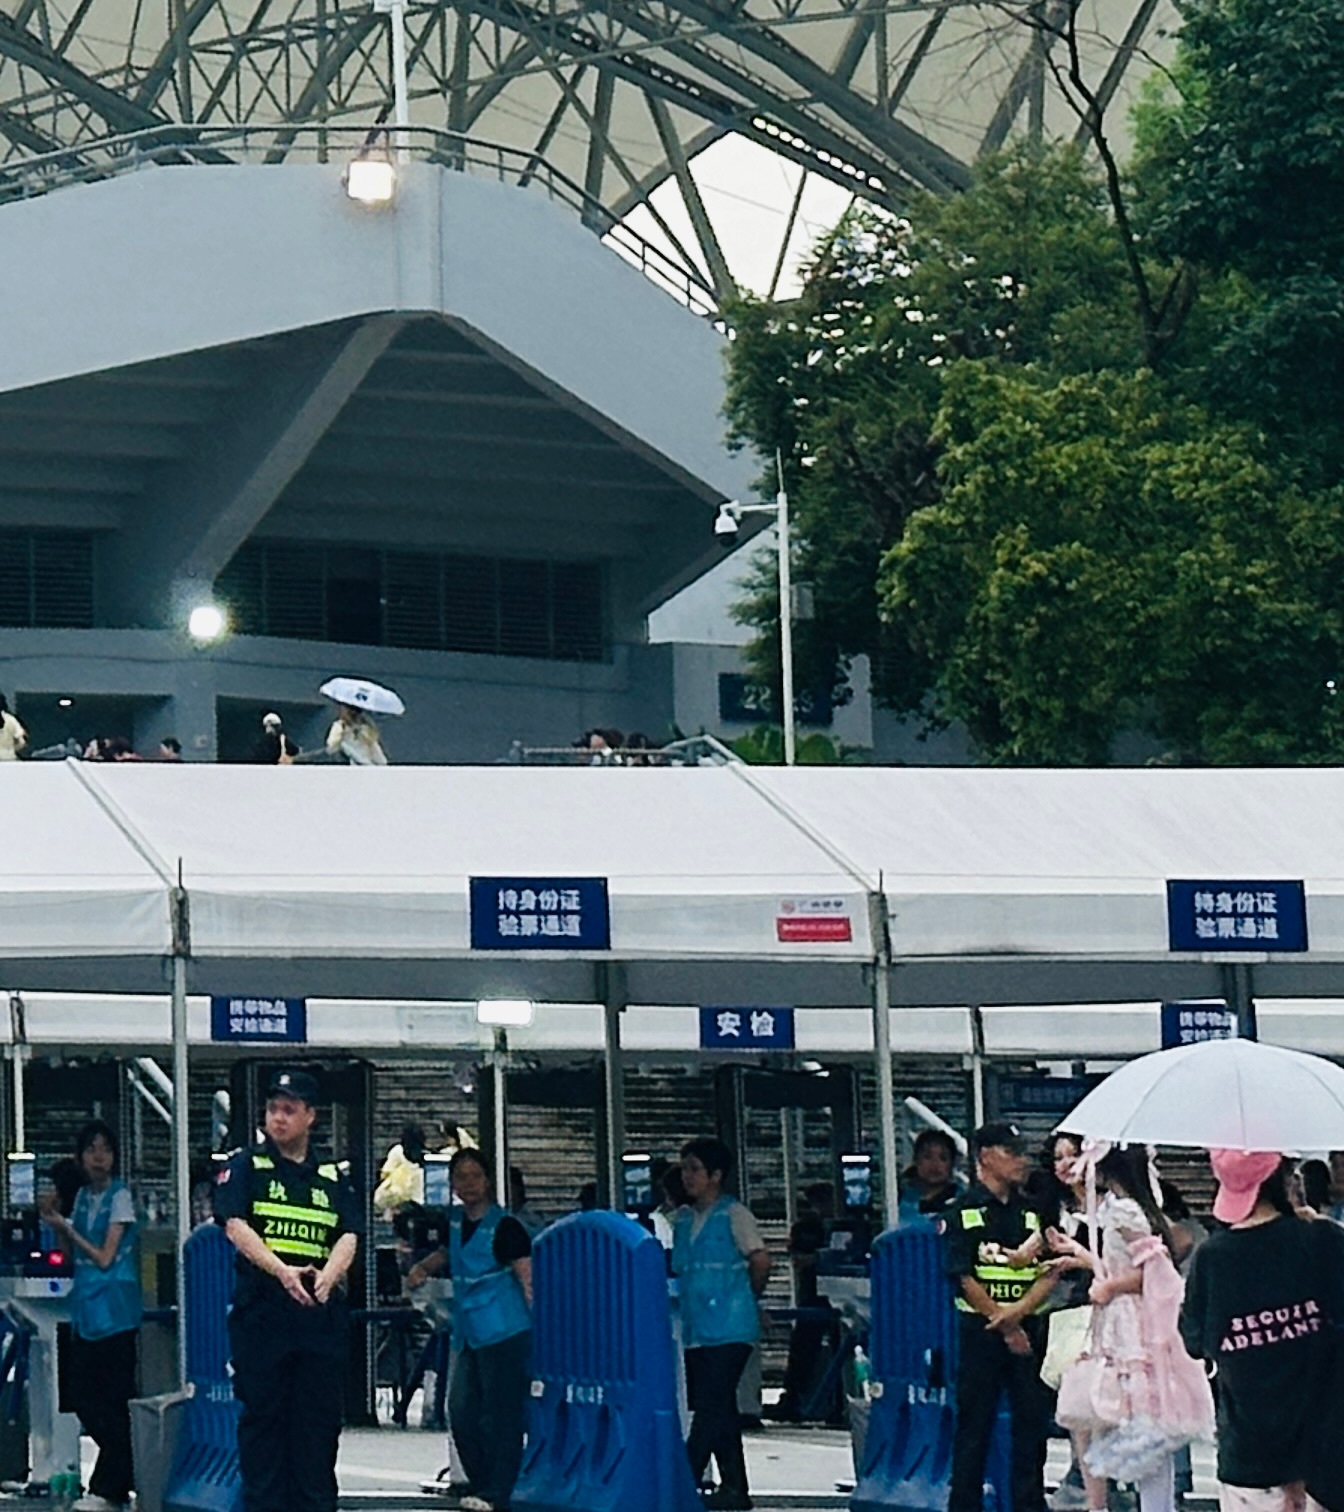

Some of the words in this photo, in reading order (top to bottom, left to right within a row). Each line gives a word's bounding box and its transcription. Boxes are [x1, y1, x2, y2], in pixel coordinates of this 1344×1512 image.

[498, 889, 581, 911] 持身份证
[1194, 891, 1277, 913] 持身份证
[717, 1012, 775, 1038] 安检
[1231, 1299, 1320, 1332] SEGUIR
[1220, 1317, 1321, 1352] ADELANT
